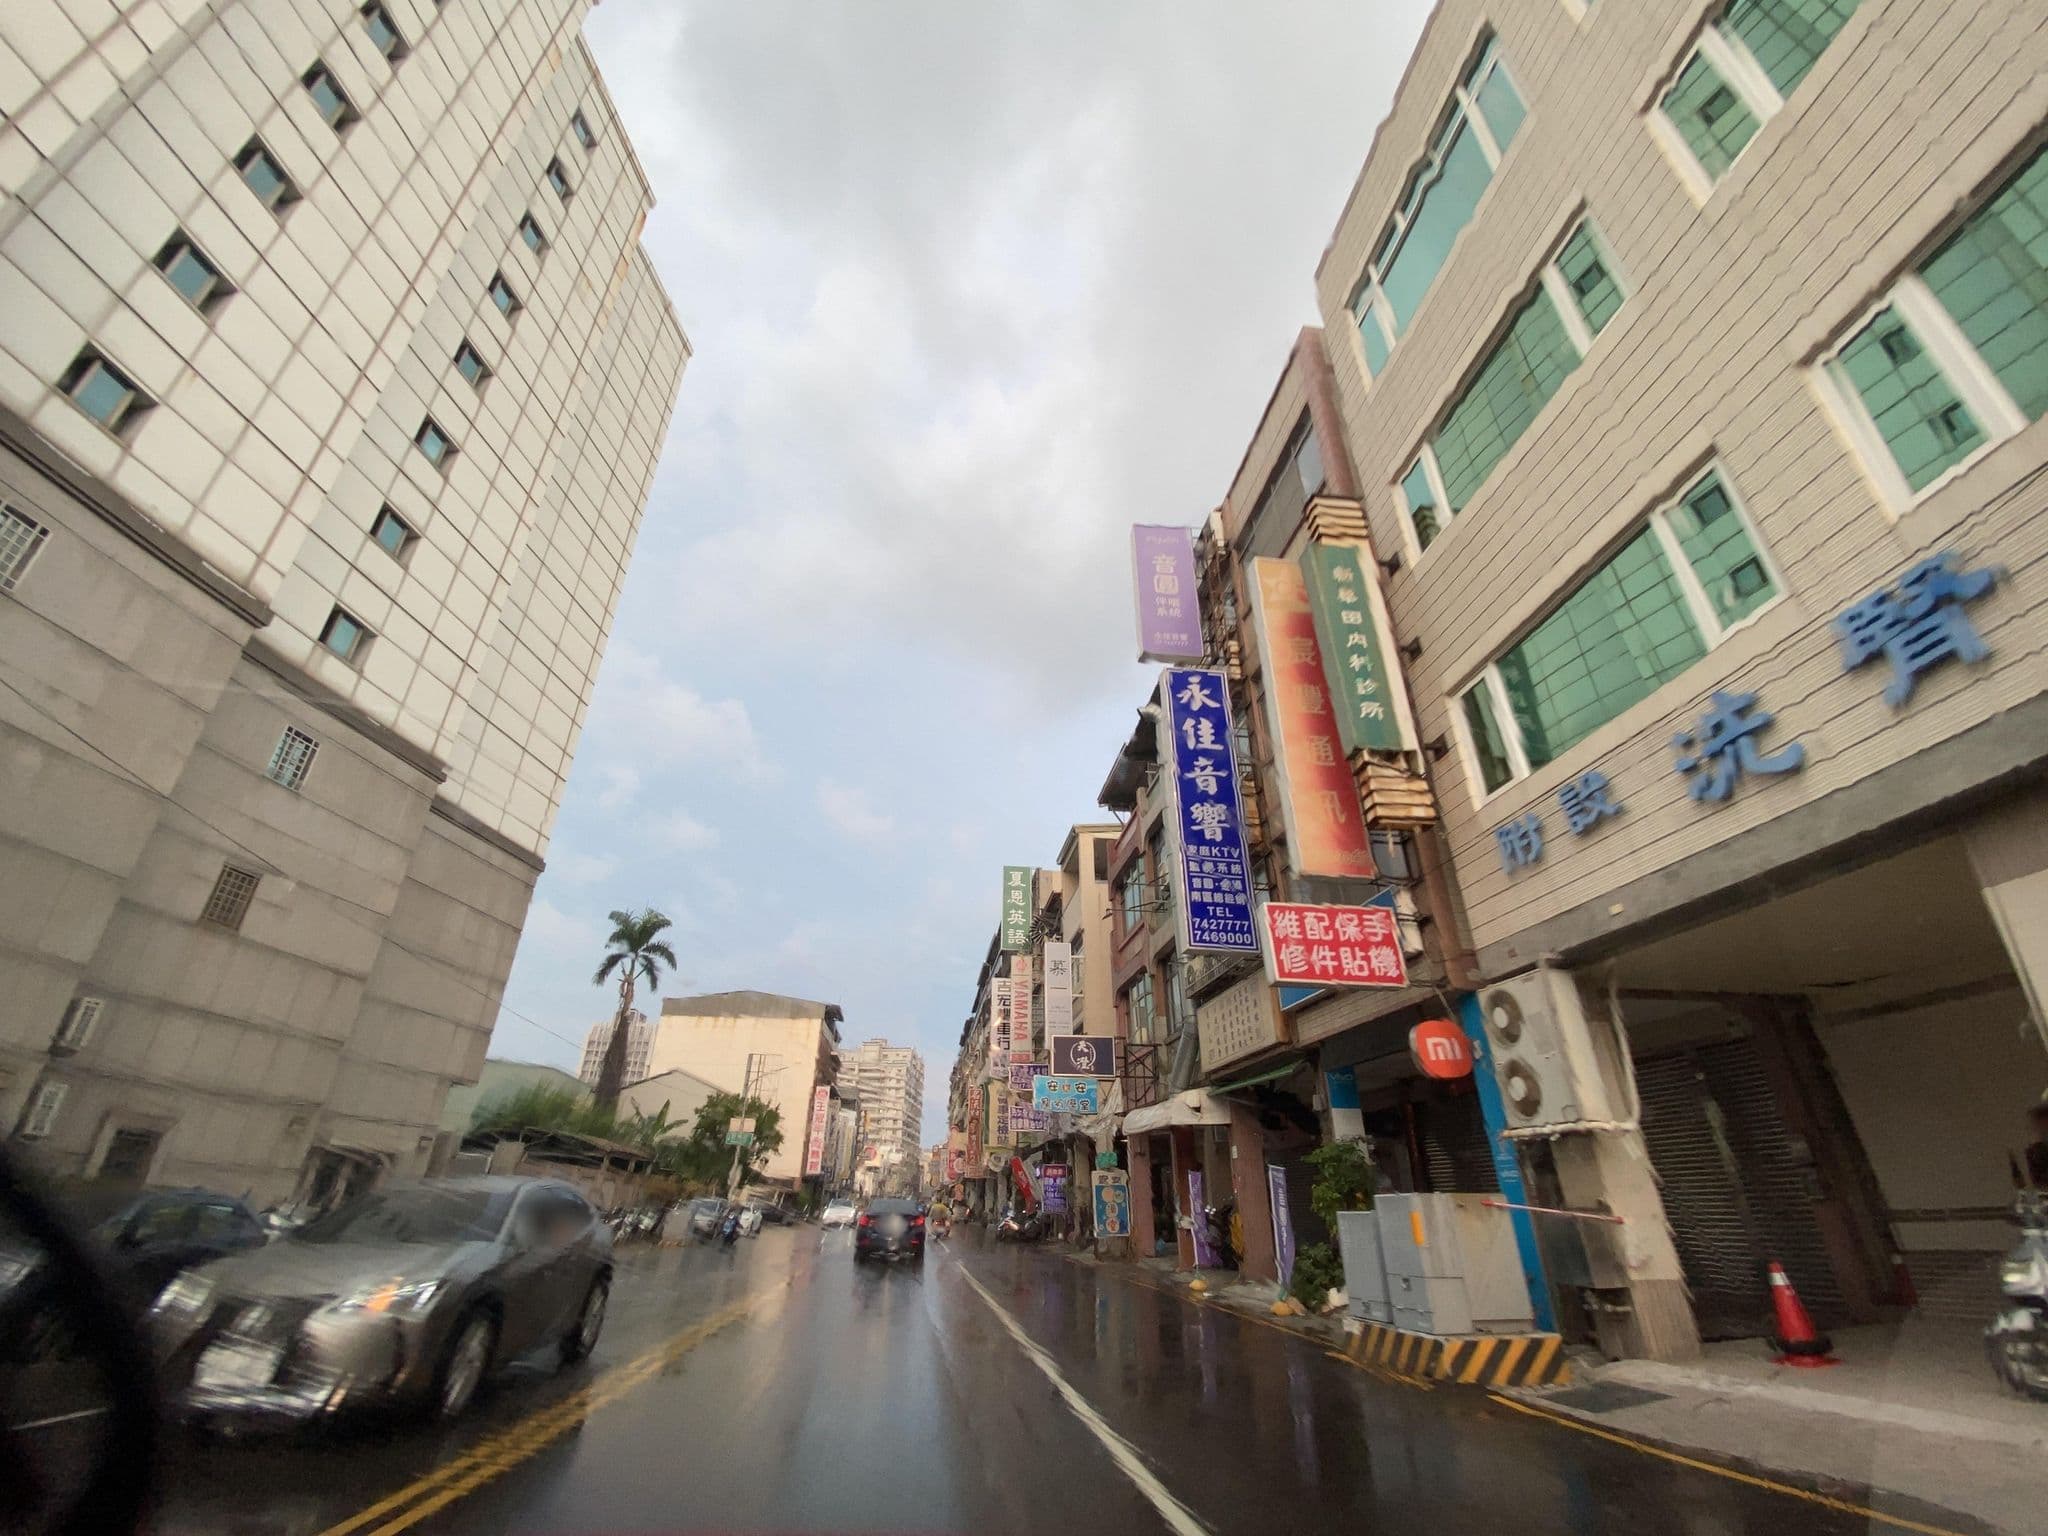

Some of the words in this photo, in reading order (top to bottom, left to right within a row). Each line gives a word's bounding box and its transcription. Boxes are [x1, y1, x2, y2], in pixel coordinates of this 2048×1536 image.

[1176, 675, 1231, 842] 永佳音響
[1007, 871, 1029, 946] 夏恩英語
[1192, 918, 1249, 931] 7427777
[1207, 906, 1234, 917] TEL
[1194, 930, 1251, 944] 7469000
[1014, 980, 1029, 1041] YAMAHA
